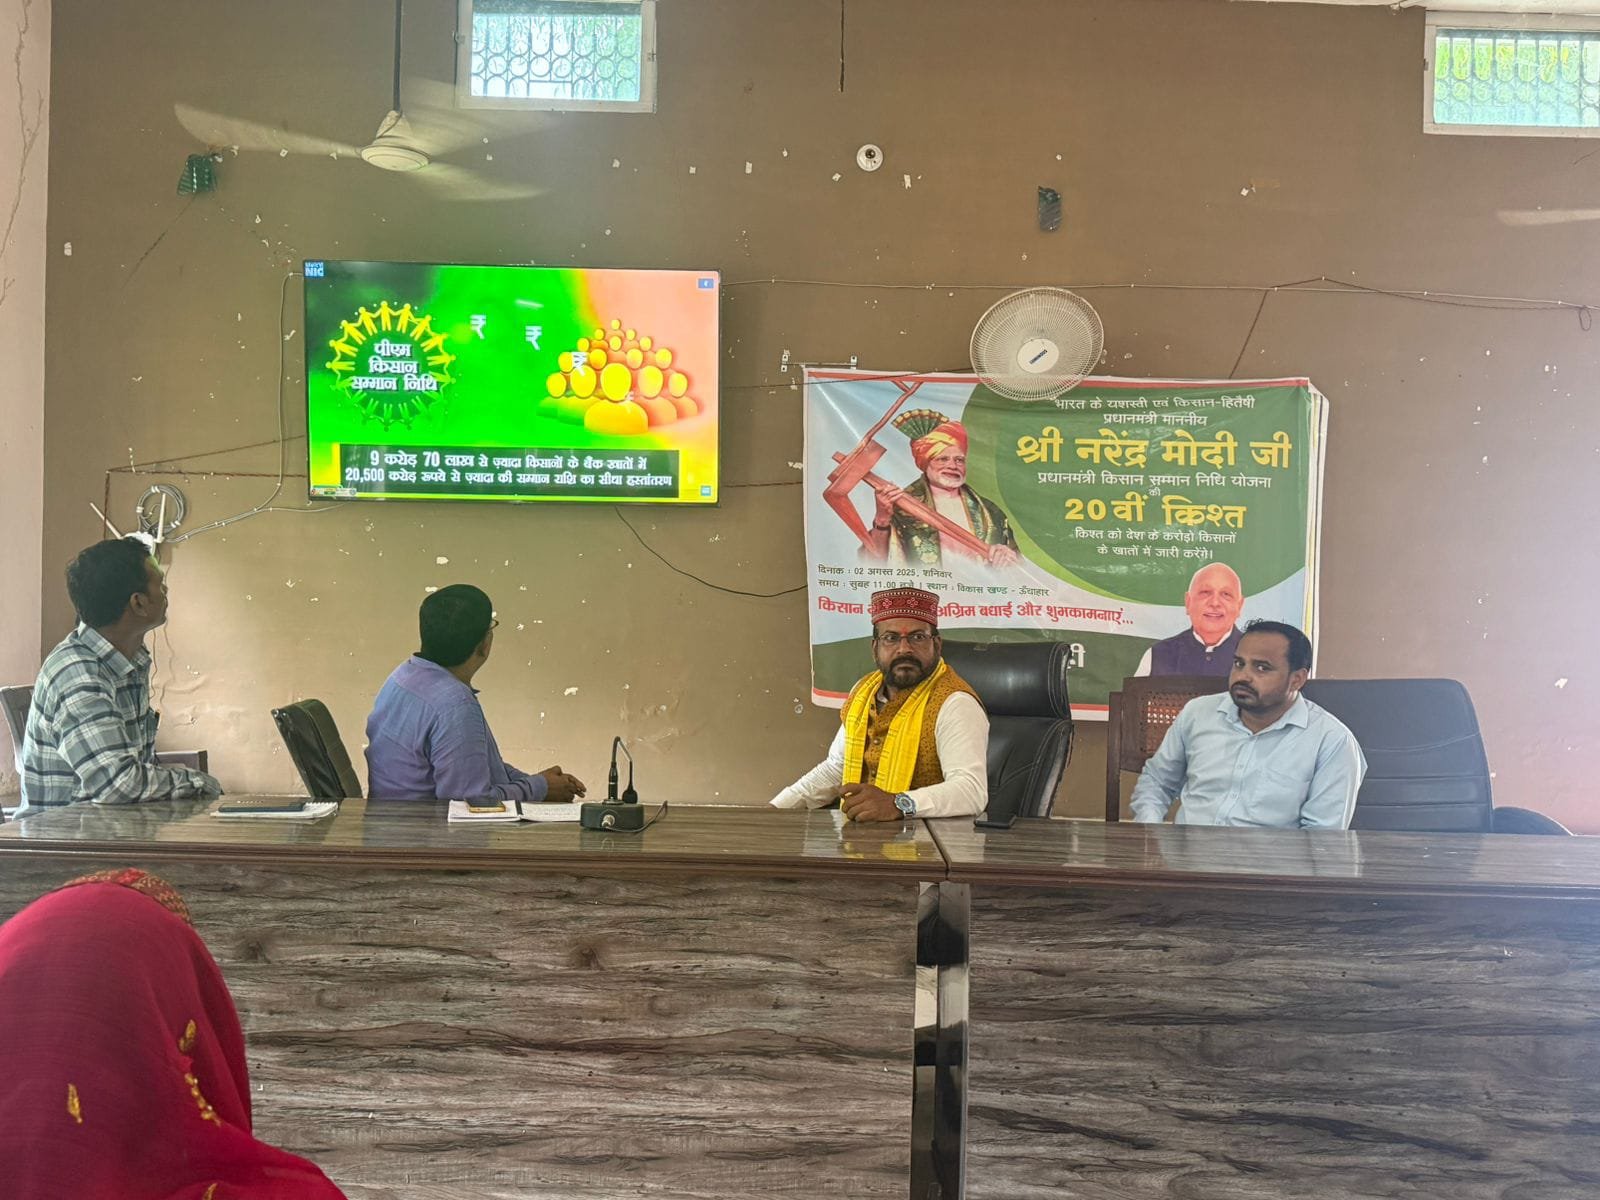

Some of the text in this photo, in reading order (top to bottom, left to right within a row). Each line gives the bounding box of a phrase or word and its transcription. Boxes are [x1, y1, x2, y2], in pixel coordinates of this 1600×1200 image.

[374, 338, 412, 357] पीएम
[368, 355, 418, 373] किसान
[351, 373, 438, 391] सम्मान निधि
[1055, 398, 1085, 410] भारत
[1090, 397, 1102, 409] के
[1107, 397, 1148, 409] यशस्वी
[1153, 397, 1169, 408] एवं
[1103, 411, 1208, 426] प्रधानमंत्री माननीय
[1016, 426, 1293, 470] श्री नरेंद्र मोदी जी
[370, 450, 380, 466] 9
[423, 451, 441, 467] 70
[445, 454, 475, 467] लाख
[478, 454, 489, 467] से
[568, 456, 579, 469] के
[638, 457, 647, 470] में
[345, 467, 385, 483] 20,500
[450, 468, 461, 482] से
[498, 469, 512, 483] की
[580, 474, 595, 485] का
[1038, 470, 1272, 488] प्रधानमंत्री किसान सम्मान निधि योजना
[1149, 486, 1161, 497] की
[1161, 494, 1247, 529] किश्त
[1108, 528, 1122, 540] को
[1126, 528, 1145, 540] देश
[1148, 529, 1160, 541] के
[1199, 531, 1237, 544] किसानों
[1096, 543, 1108, 555] के
[1112, 544, 1138, 556] खातों
[1143, 546, 1151, 556] में
[1155, 546, 1179, 559] जारी
[854, 567, 864, 575] 02
[868, 567, 893, 576] अगस्त
[922, 568, 953, 579] शनिवार
[818, 579, 839, 588] समय
[850, 579, 870, 590] सुबह
[873, 581, 896, 589] 11.00
[926, 582, 948, 591] स्थान
[957, 583, 983, 594] विकास
[818, 595, 864, 615] किसान
[937, 602, 976, 618] अग्रिम
[979, 601, 1012, 618] बधाई
[1017, 601, 1043, 617] और
